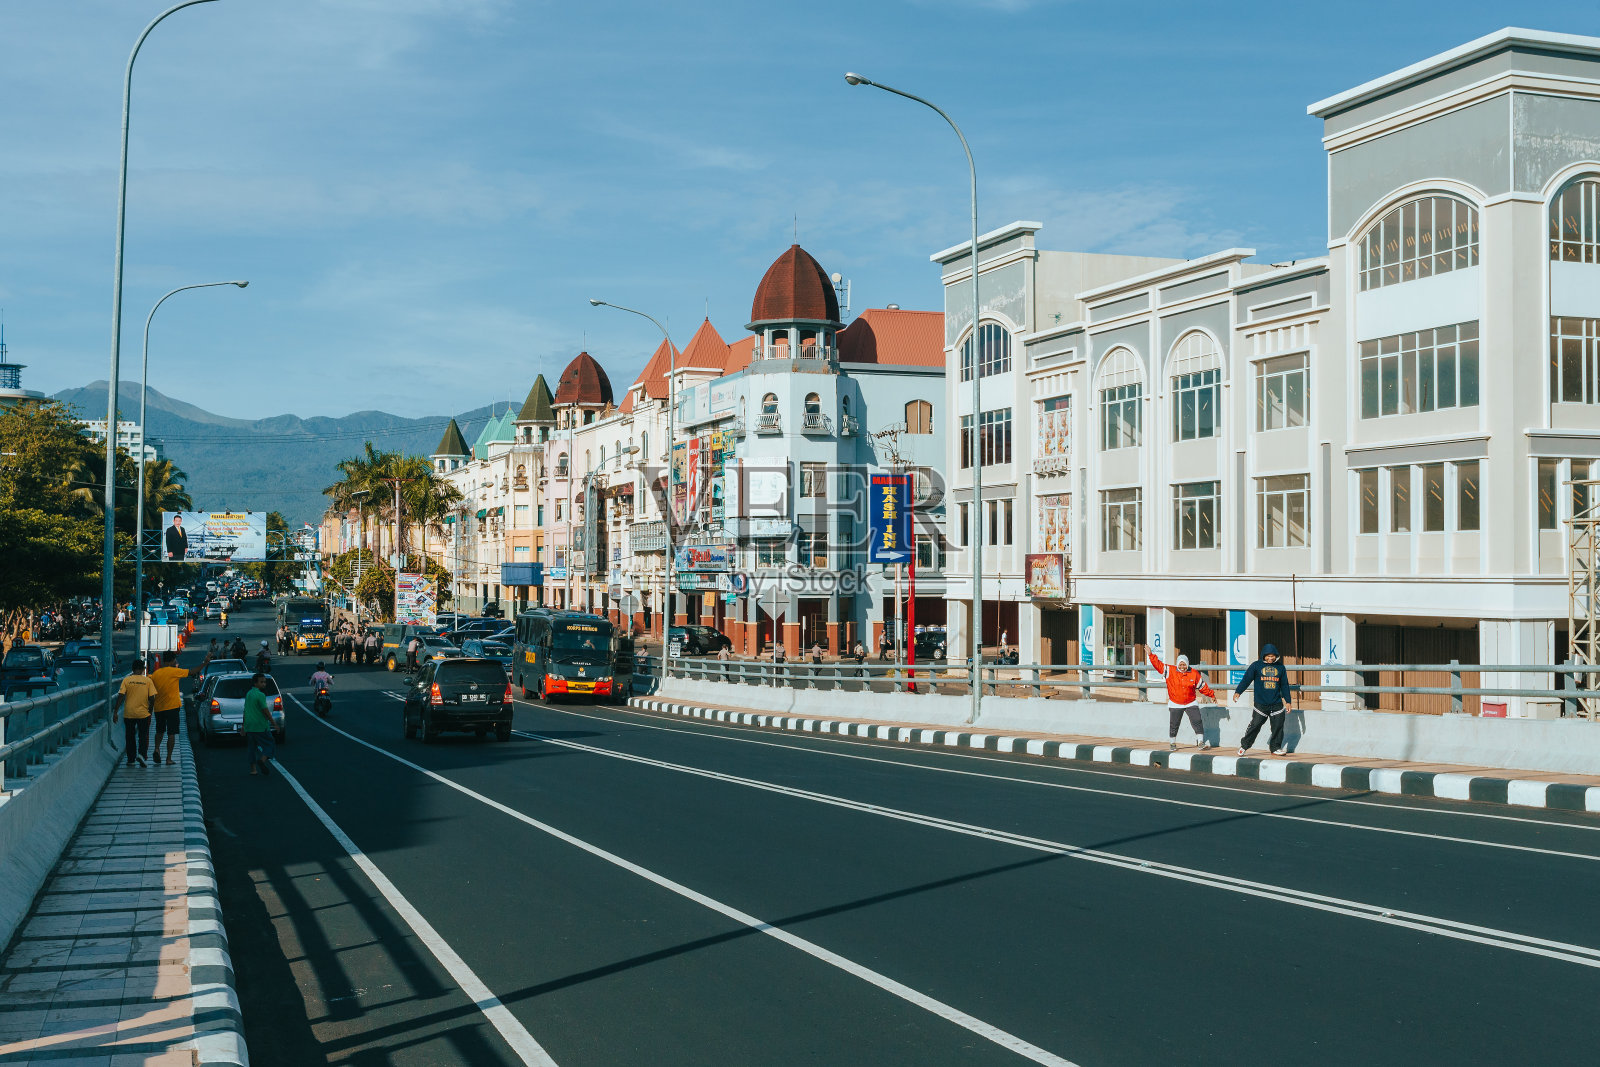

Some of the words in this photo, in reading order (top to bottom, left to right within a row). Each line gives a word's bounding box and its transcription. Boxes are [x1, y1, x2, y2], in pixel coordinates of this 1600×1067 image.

[882, 487, 898, 519] HASH
[883, 524, 896, 549] INN
[1329, 638, 1338, 660] k
